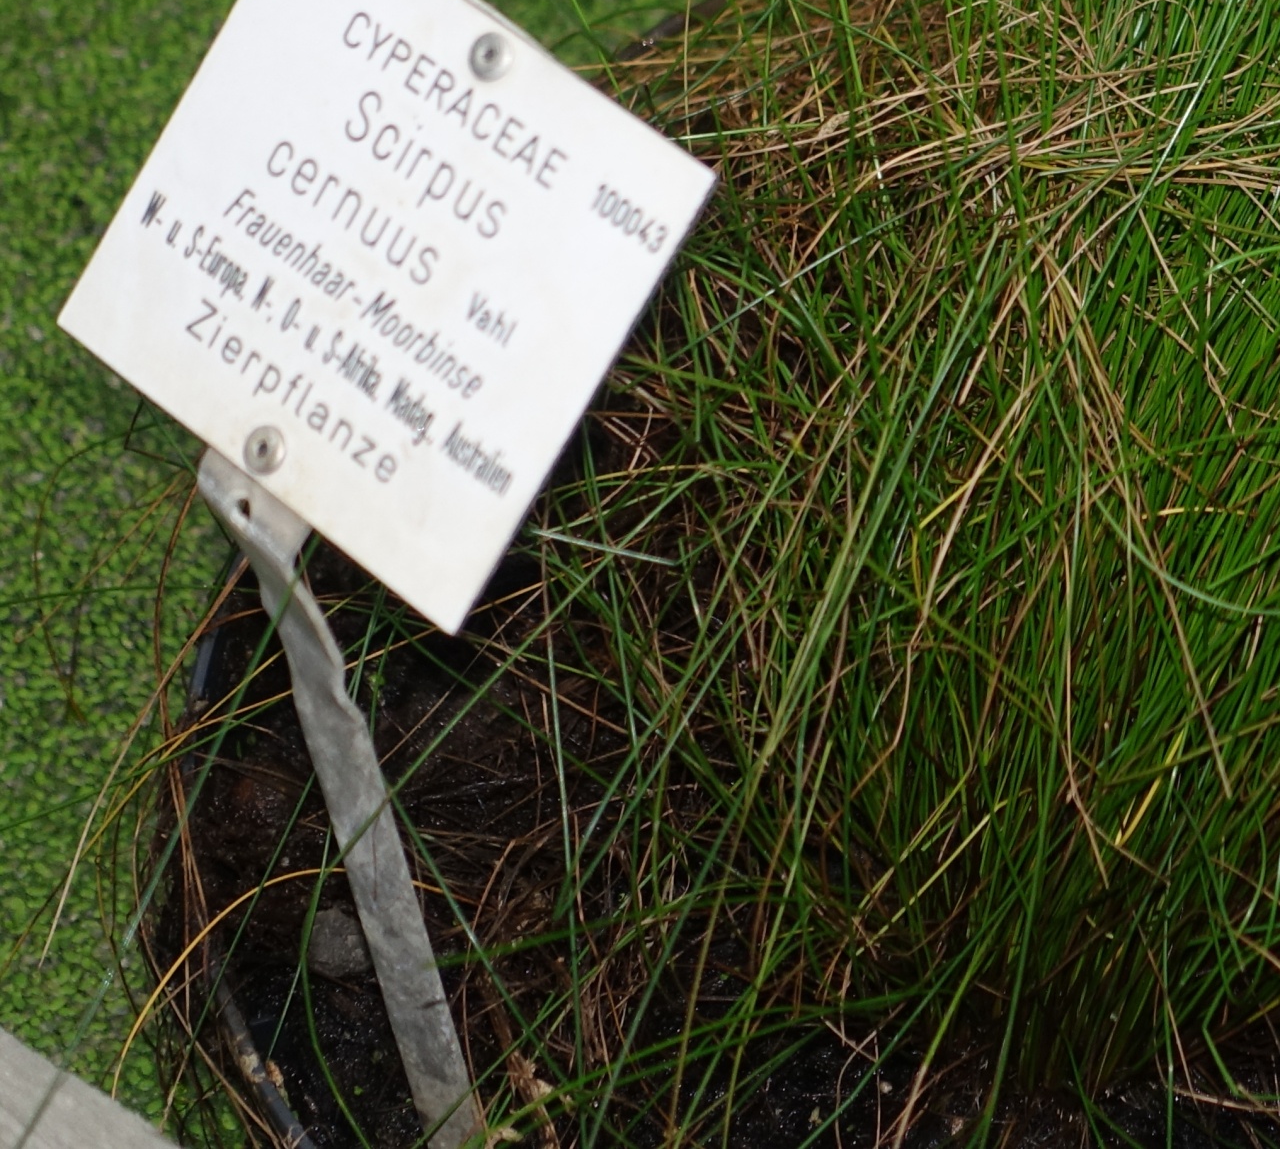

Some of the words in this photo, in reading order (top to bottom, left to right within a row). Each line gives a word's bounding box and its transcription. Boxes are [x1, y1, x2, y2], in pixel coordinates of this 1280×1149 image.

[342, 11, 569, 190] CYPERACEAE
[591, 184, 668, 253] 100043
[344, 89, 507, 240] Scirpus
[140, 190, 166, 228] W-
[166, 220, 182, 248] u.
[281, 298, 302, 332] O-
[440, 420, 513, 497] Australien
[266, 140, 440, 286] cernuus
[467, 292, 517, 347] Vahl
[184, 297, 398, 484] Zierpflanze
